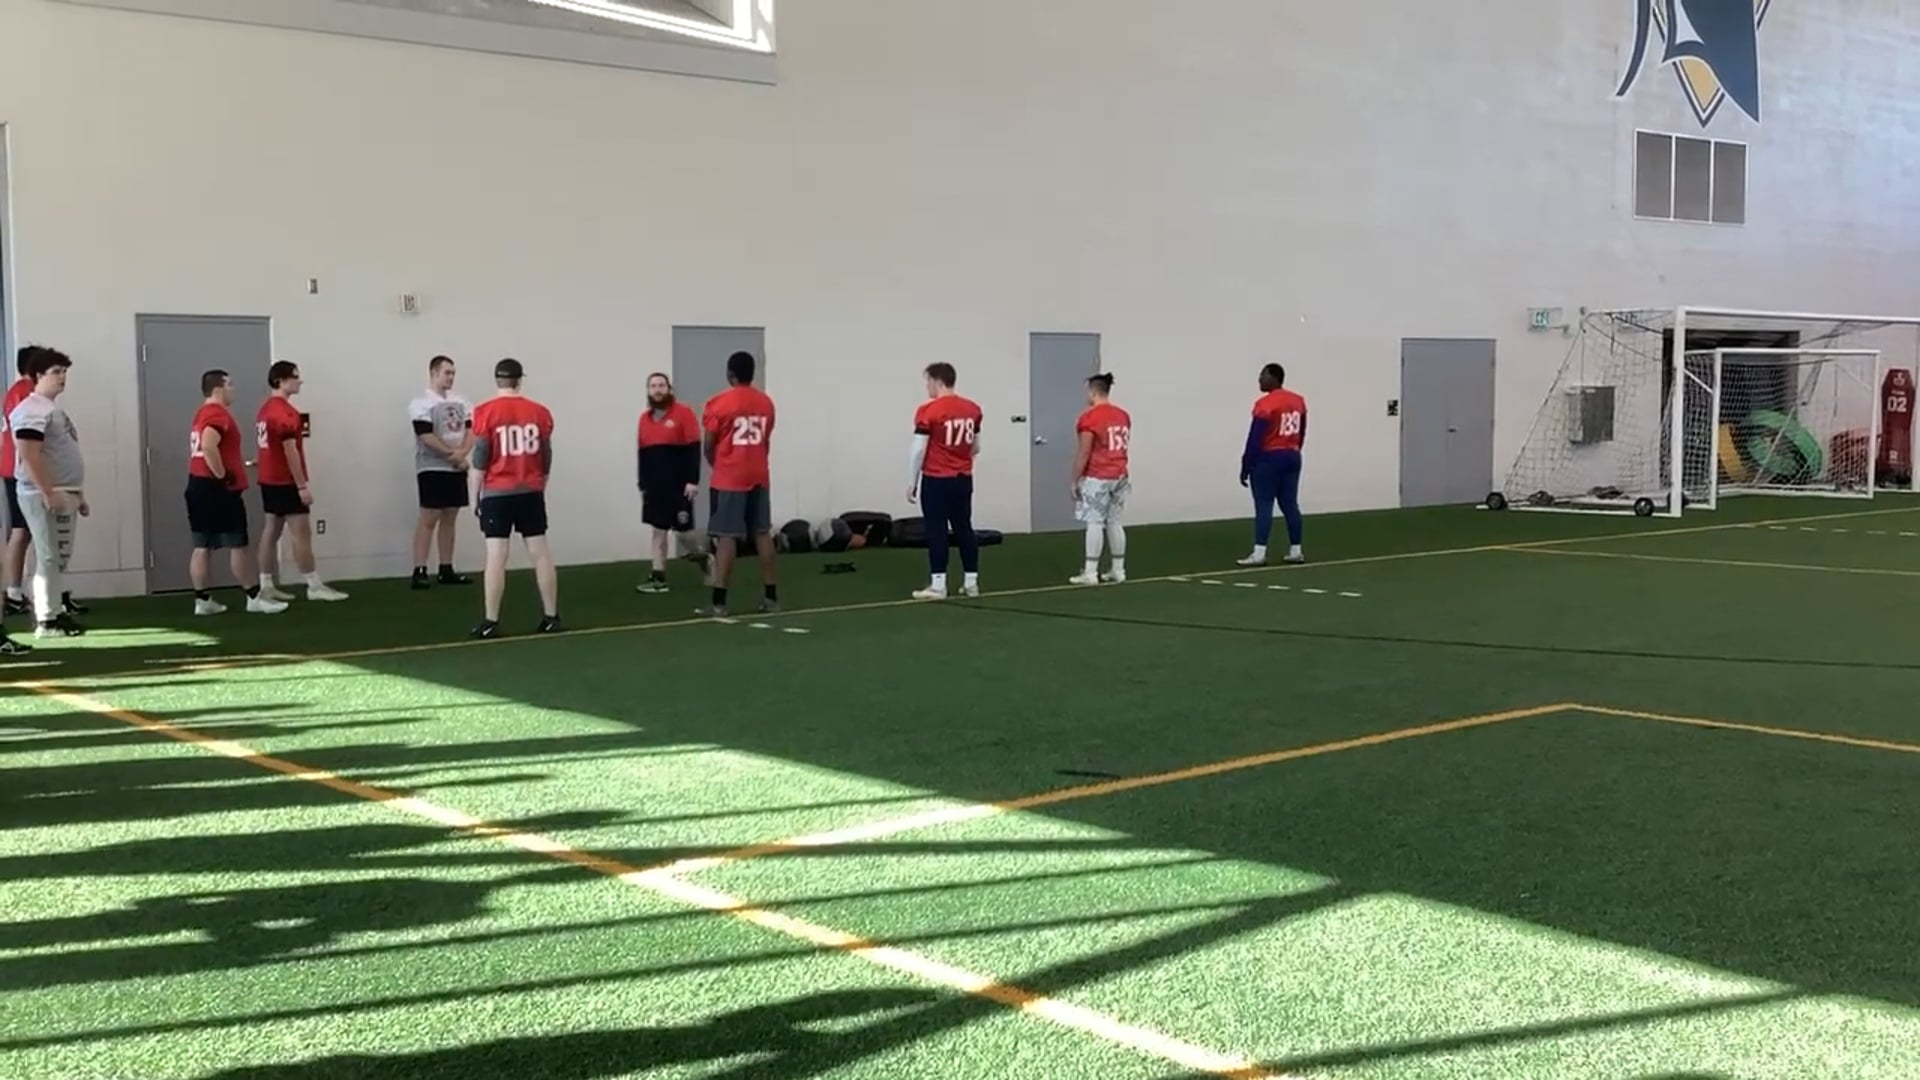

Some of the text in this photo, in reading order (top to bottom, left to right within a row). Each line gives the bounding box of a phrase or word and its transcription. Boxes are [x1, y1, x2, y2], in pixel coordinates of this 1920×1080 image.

[1887, 395, 1907, 413] 02
[496, 423, 539, 457] 108
[732, 415, 767, 446] 251
[944, 418, 975, 446] 178
